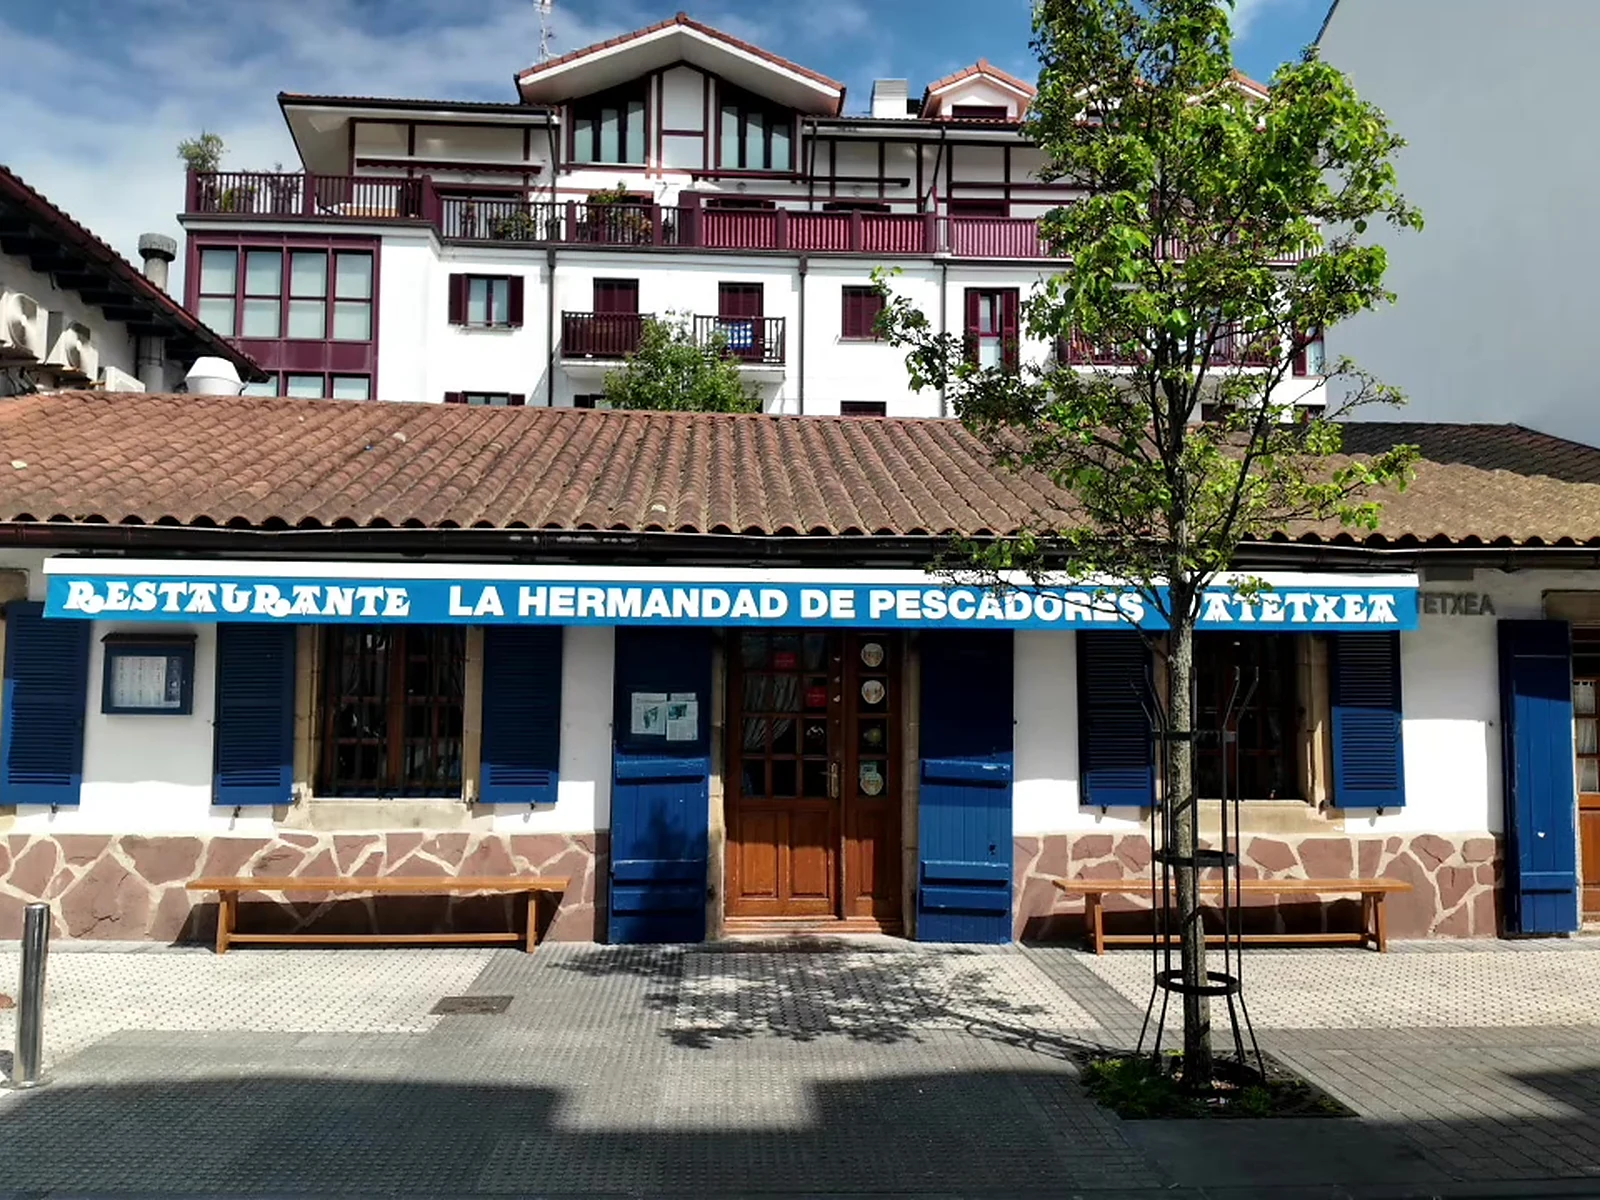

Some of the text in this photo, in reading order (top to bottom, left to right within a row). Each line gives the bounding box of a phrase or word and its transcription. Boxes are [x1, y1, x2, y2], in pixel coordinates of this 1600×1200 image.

[63, 580, 1398, 623] RESTAURANTE LA HERMANDAD DE PESCADORES ATETXEA
